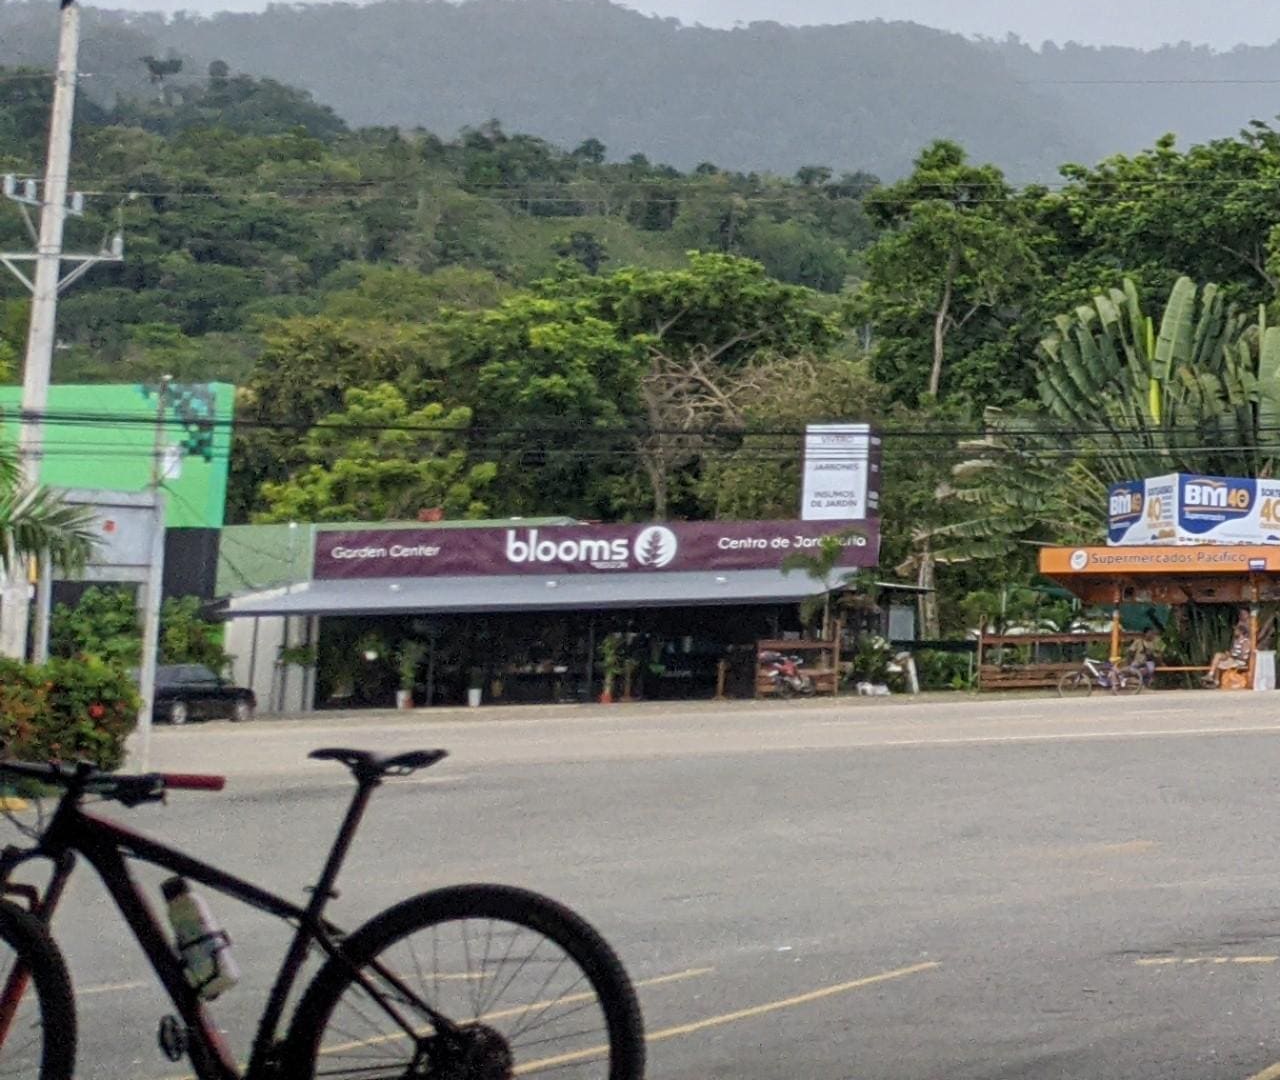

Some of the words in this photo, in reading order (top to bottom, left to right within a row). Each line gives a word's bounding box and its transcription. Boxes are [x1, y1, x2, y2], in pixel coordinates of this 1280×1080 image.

[810, 499, 822, 508] DE
[506, 529, 630, 563] blooms
[718, 536, 767, 550] Centro
[770, 535, 791, 549] de
[330, 546, 386, 559] Garden
[389, 544, 440, 558] Center
[1091, 552, 1193, 565] Supermercados
